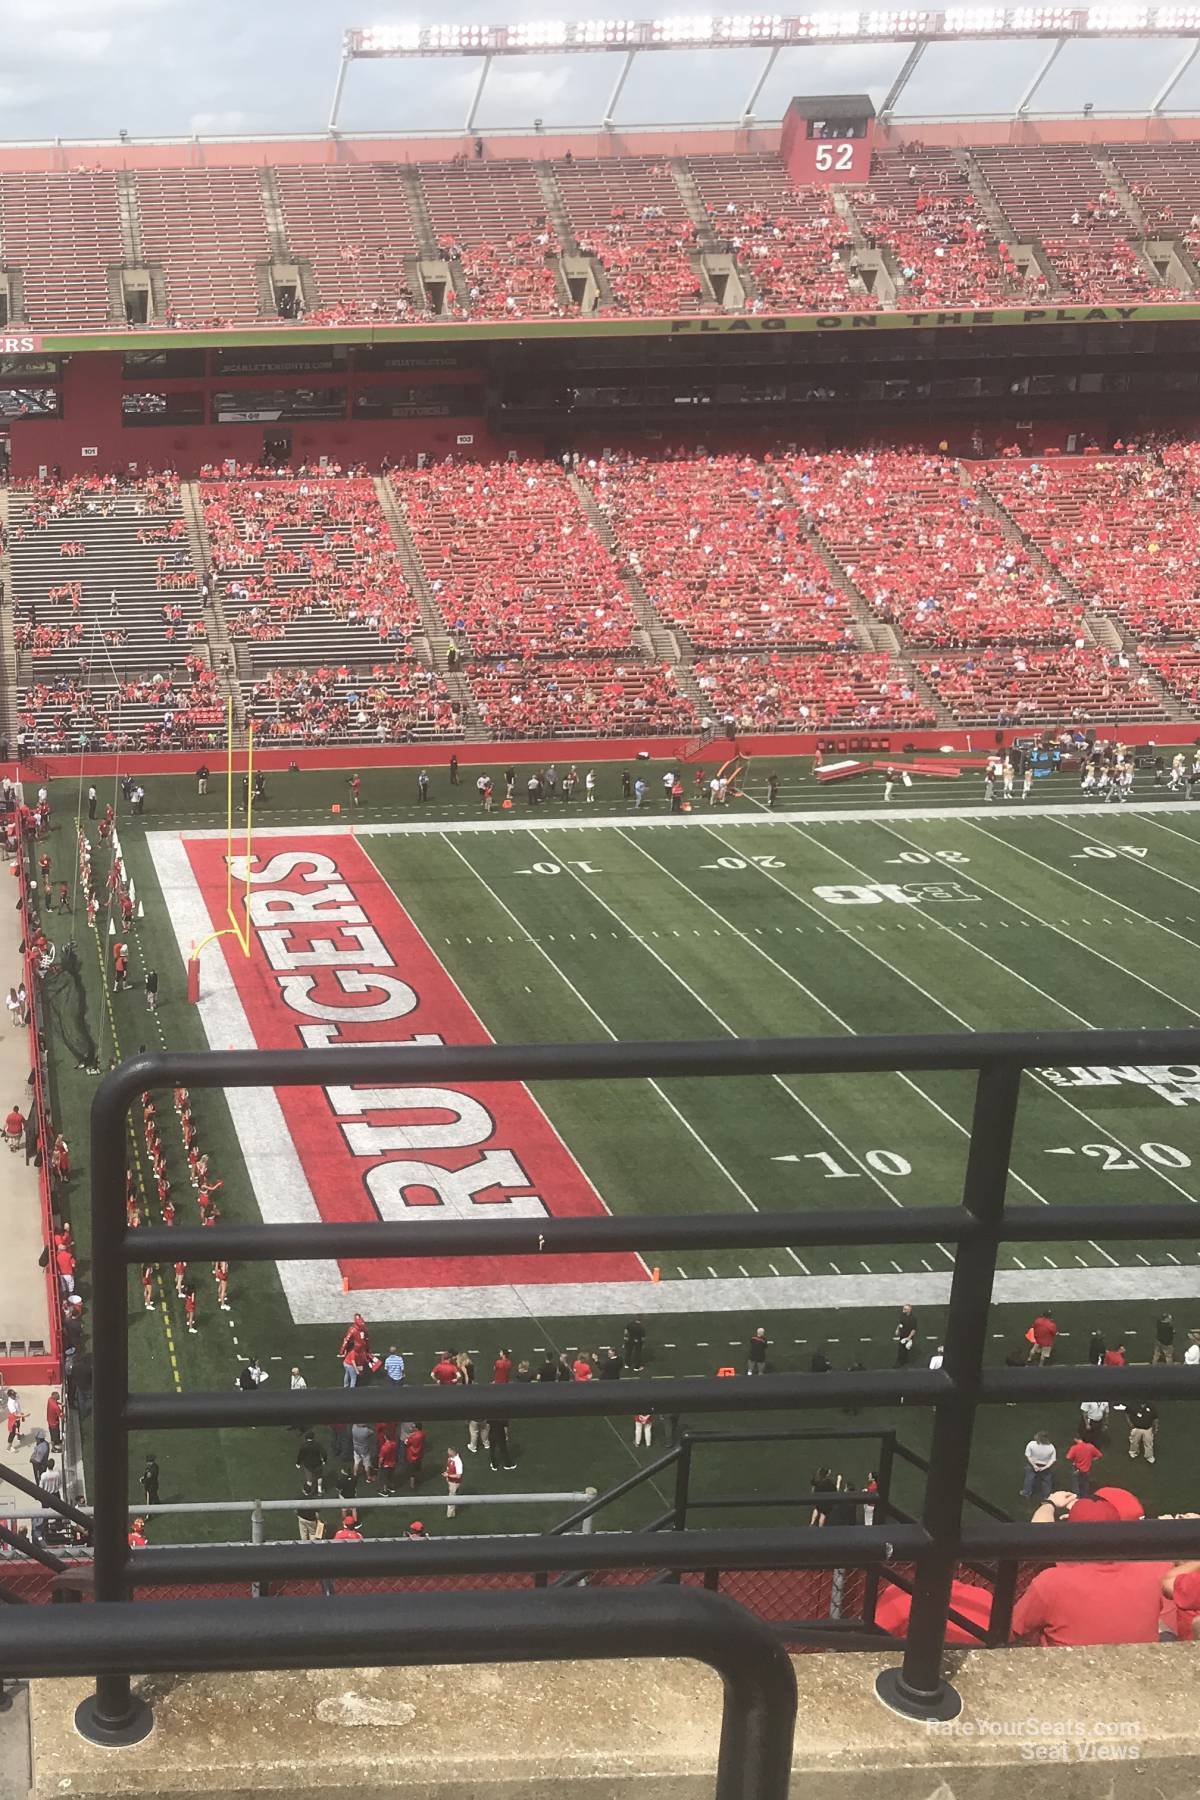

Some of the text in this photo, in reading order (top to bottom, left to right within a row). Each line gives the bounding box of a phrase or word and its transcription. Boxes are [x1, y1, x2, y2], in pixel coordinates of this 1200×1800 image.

[815, 143, 854, 171] 52
[671, 306, 1140, 333] FLAG ON THE PLAY
[532, 860, 603, 875] 10
[717, 855, 786, 869] 20
[899, 850, 971, 865] 30
[803, 1149, 912, 1178] 10
[1081, 1142, 1192, 1171] 20
